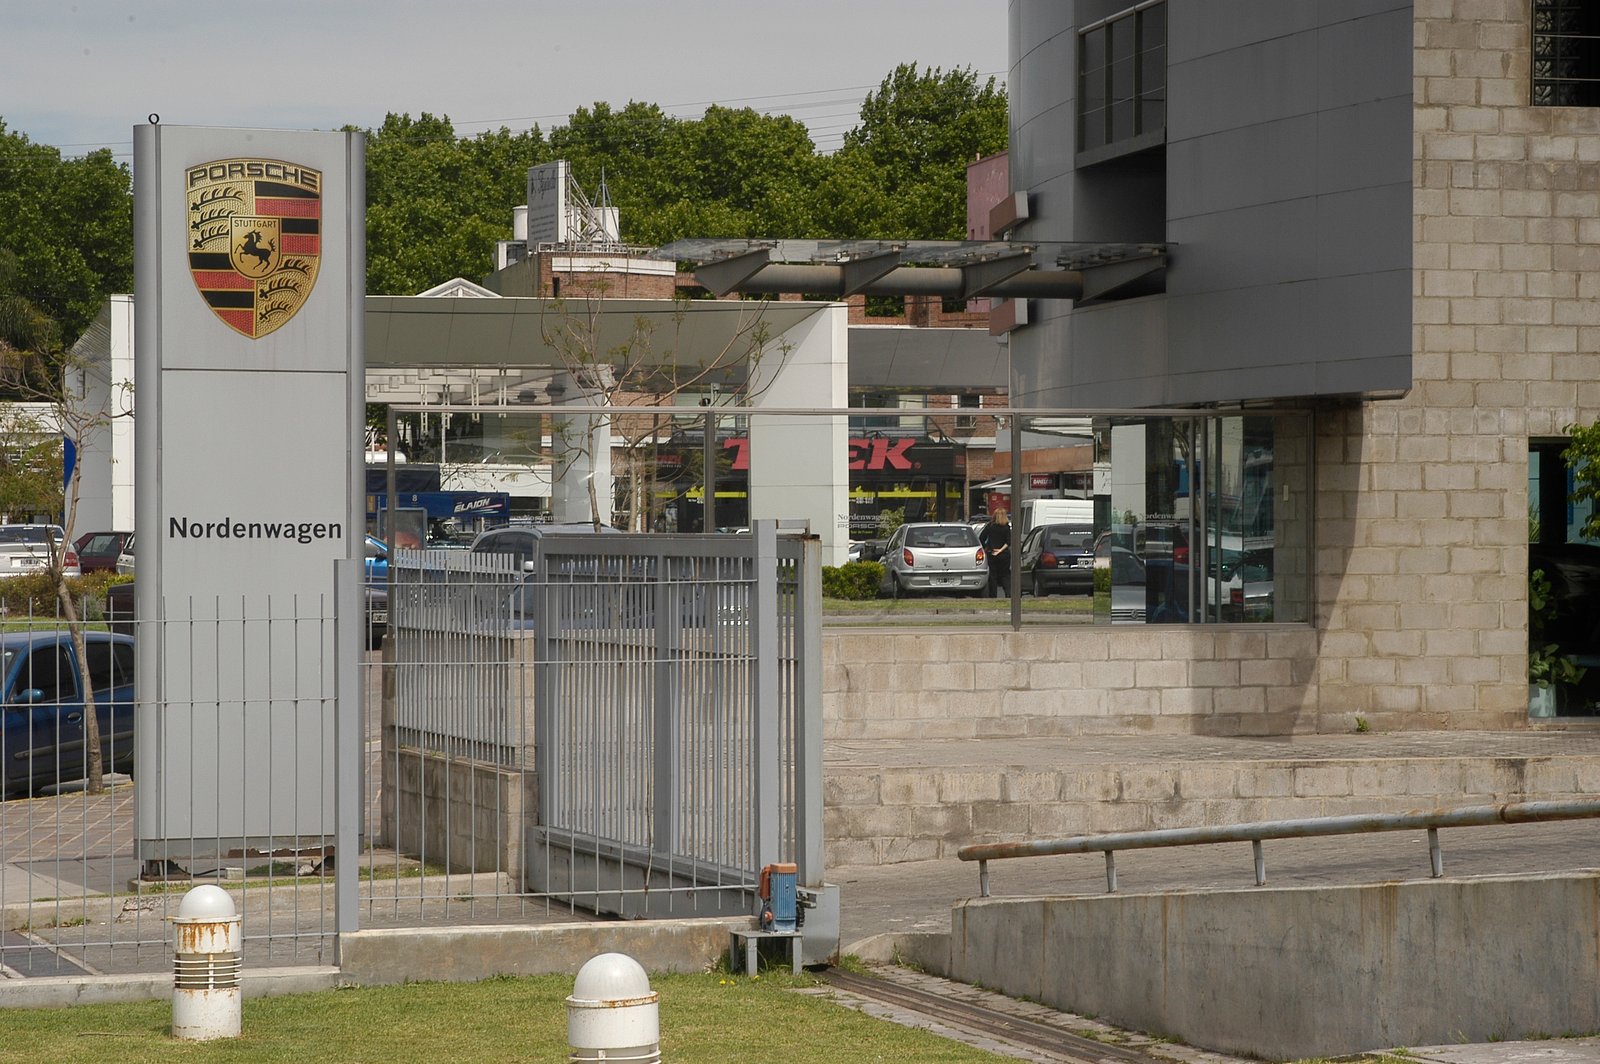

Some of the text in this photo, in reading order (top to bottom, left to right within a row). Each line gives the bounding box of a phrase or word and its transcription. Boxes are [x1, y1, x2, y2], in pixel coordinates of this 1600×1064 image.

[189, 162, 319, 189] PORSCHE
[234, 220, 277, 228] STUTTGART
[169, 517, 342, 544] Nordenwagen
